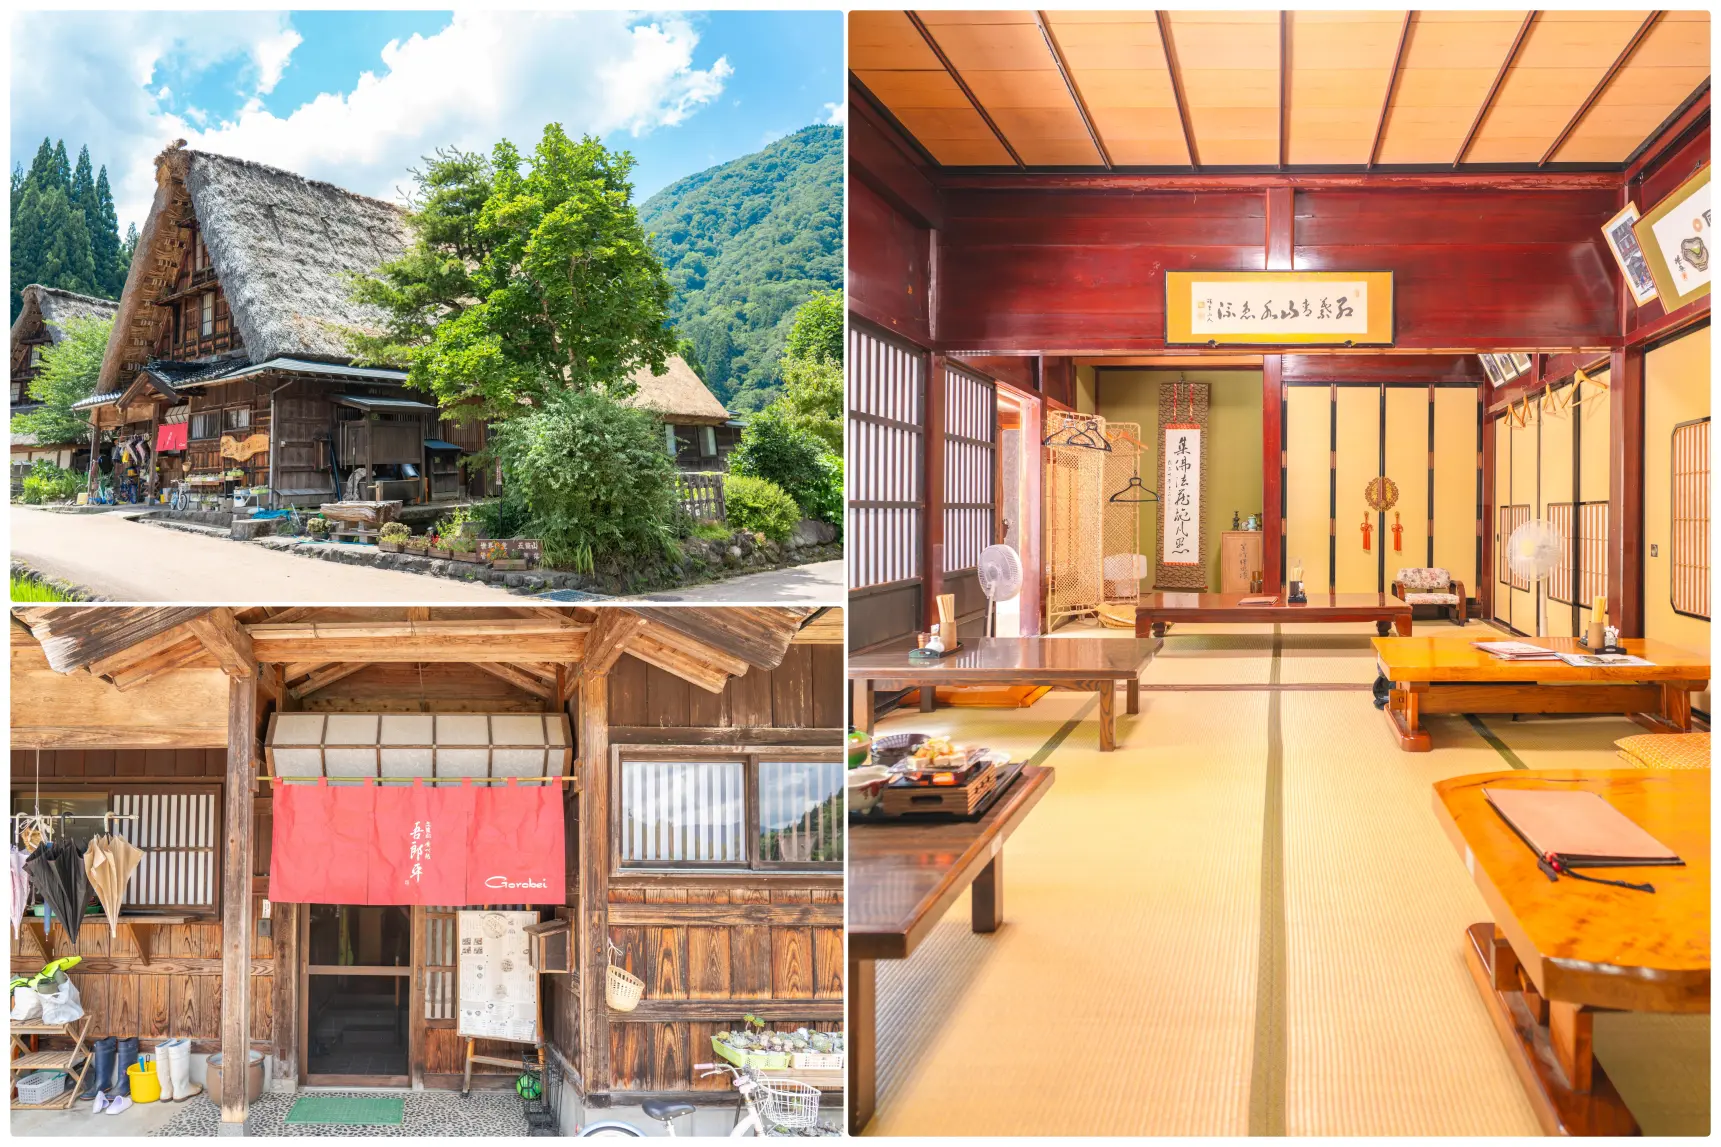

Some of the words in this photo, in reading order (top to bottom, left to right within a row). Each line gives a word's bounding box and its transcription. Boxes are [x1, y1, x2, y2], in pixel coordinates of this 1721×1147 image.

[409, 821, 424, 882] 吾郎平
[484, 875, 548, 889] Gorobei
